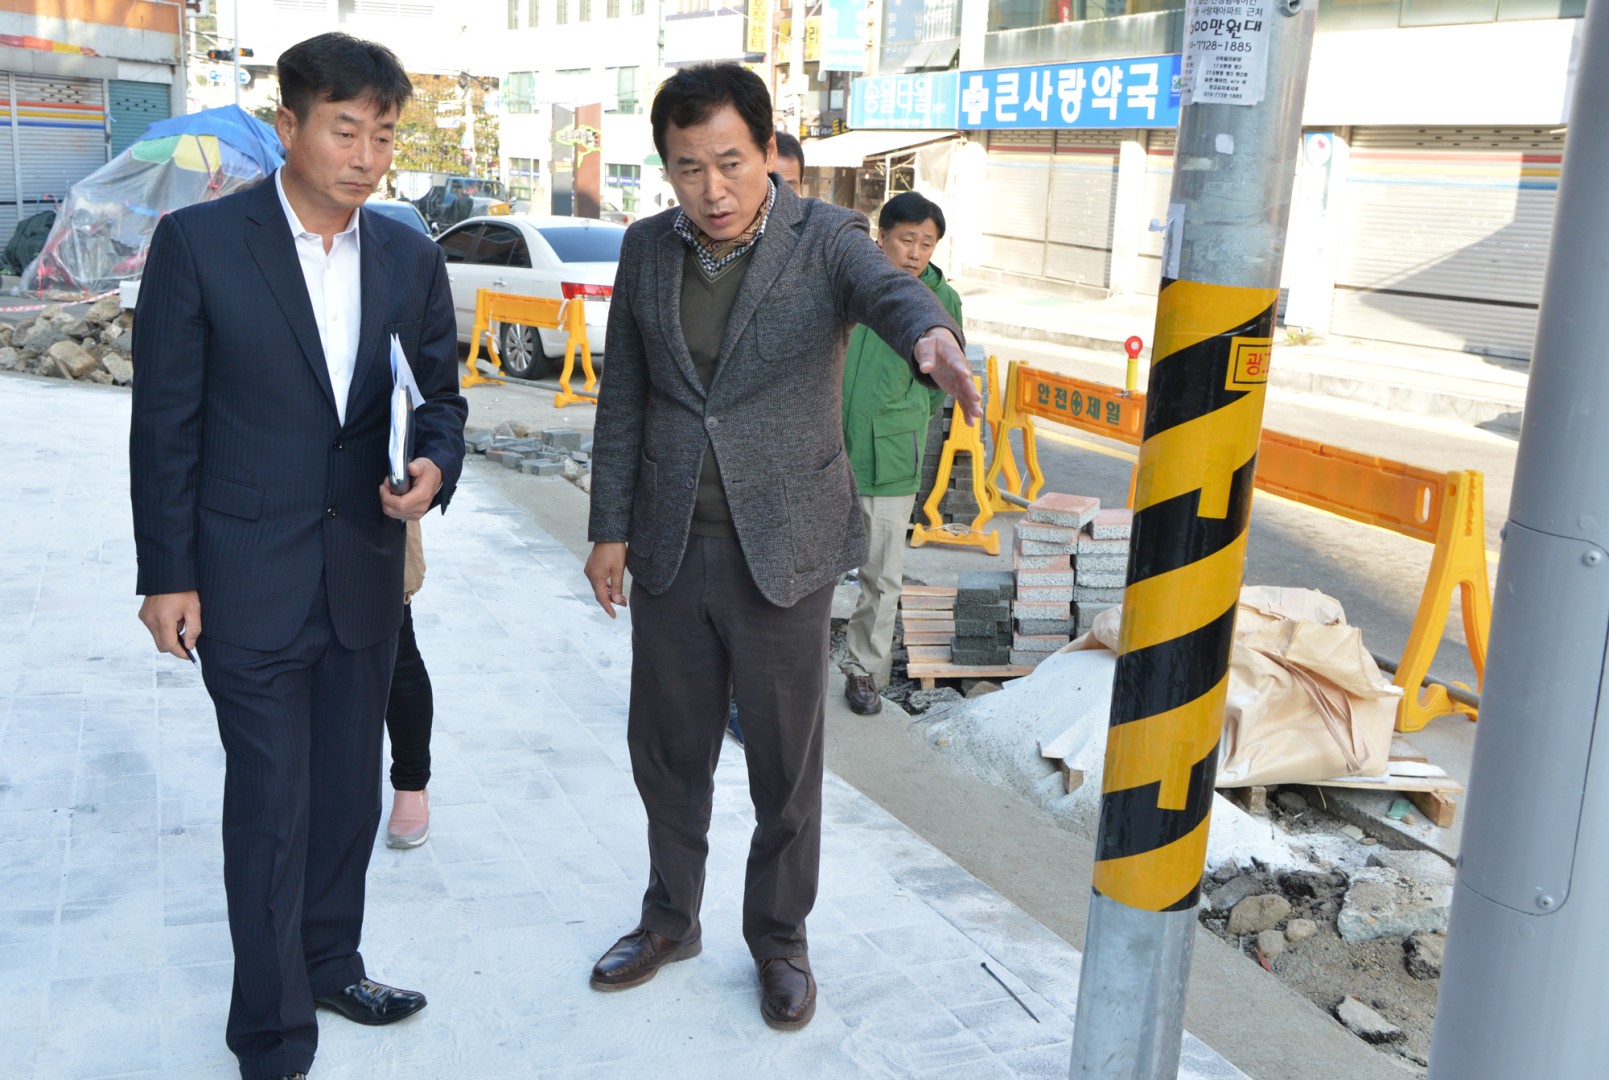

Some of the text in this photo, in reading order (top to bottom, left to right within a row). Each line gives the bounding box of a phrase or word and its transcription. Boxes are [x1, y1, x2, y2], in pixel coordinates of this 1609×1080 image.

[1246, 7, 1264, 17] 근처
[994, 63, 1159, 124] 큰사랑약국
[1037, 383, 1121, 425] 안전 제일
